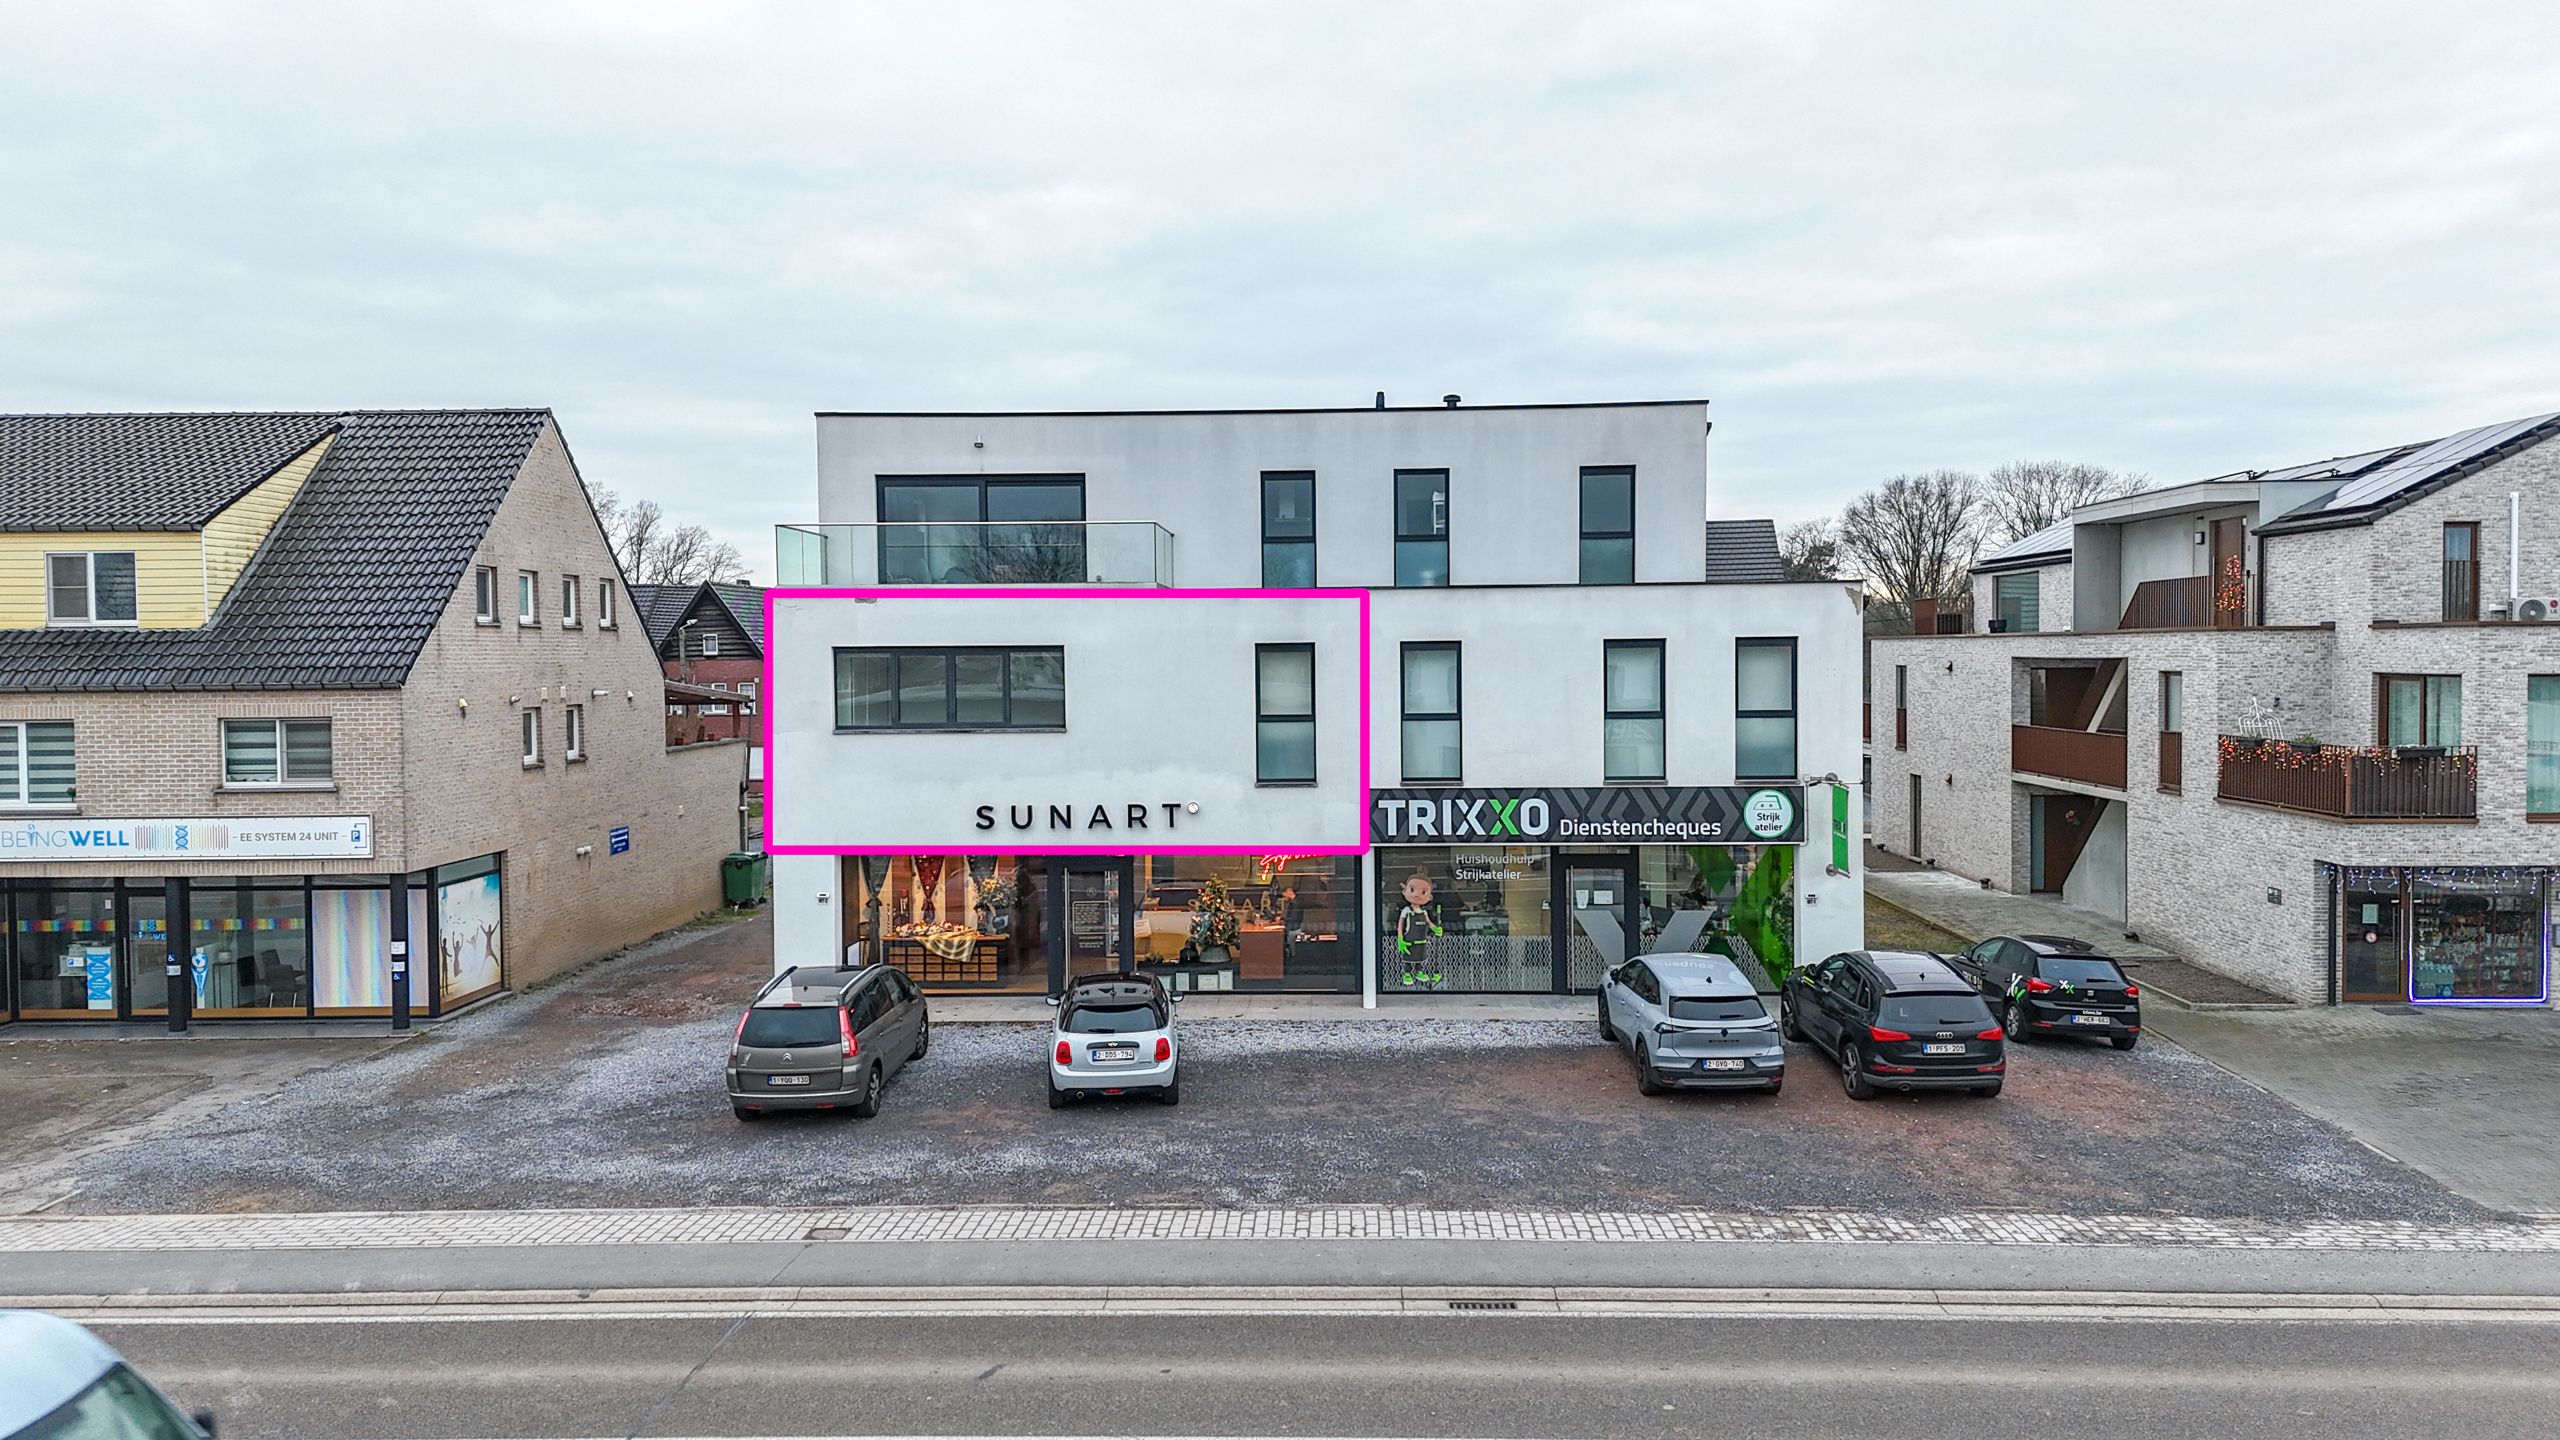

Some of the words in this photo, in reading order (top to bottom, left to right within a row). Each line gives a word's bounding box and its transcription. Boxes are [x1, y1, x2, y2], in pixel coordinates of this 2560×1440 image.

[975, 803, 1181, 830] SUNART
[1378, 798, 1549, 837] TRIXXO
[1757, 812, 1780, 822] Strijk
[1559, 818, 1721, 840] Dienstencheques
[1754, 823, 1783, 831] atelier
[240, 832, 252, 842] EE
[254, 832, 296, 842] SYSTEM
[299, 832, 311, 841] 24
[314, 831, 338, 841] UNIT
[1455, 853, 1534, 866] Huishoudhulp
[1455, 868, 1522, 882] Strijkatelier
